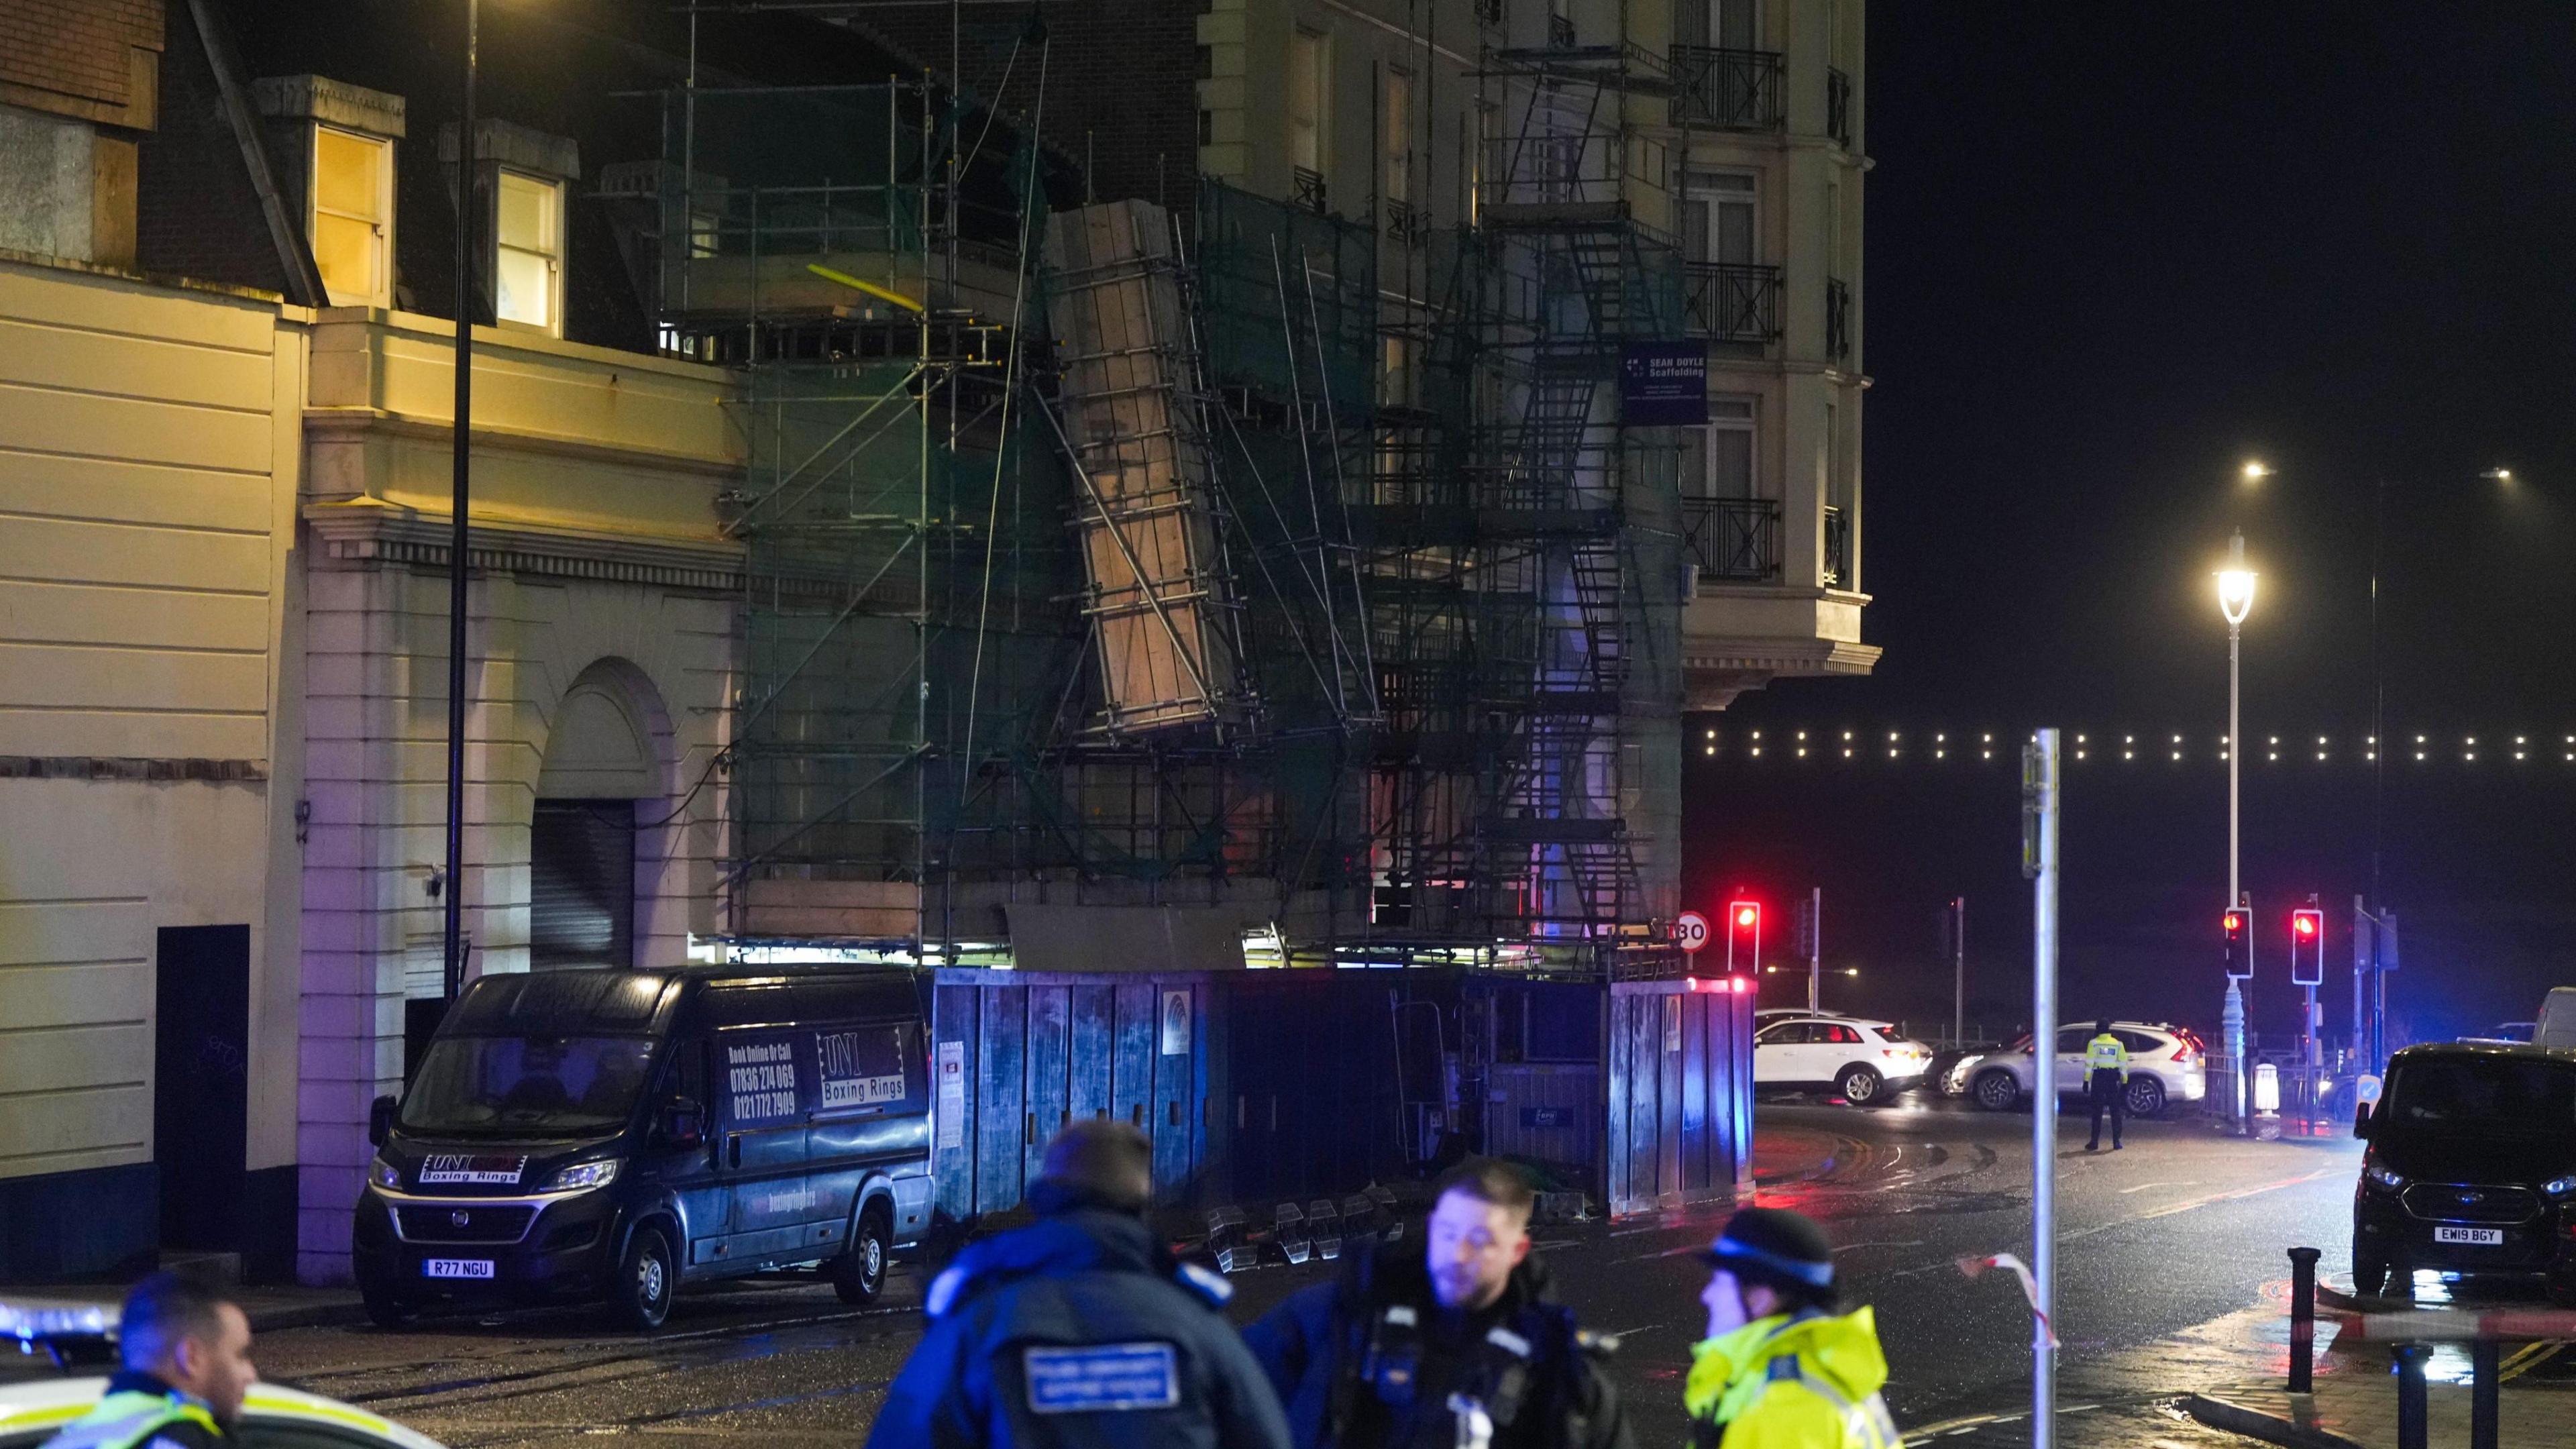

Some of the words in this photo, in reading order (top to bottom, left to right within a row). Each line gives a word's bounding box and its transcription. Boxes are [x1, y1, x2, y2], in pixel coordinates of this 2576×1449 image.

[1650, 358, 1673, 367] SEAN
[1676, 357, 1705, 367] DOYLE
[1650, 367, 1705, 378] Scaffolding
[1678, 923, 1705, 941] 30
[728, 1046, 747, 1064] Book
[746, 1044, 769, 1063] Online
[769, 1043, 777, 1061] Or
[777, 1042, 792, 1061] Call
[730, 1067, 759, 1093] 07836
[759, 1065, 775, 1090] 274
[776, 1064, 794, 1089] 069
[824, 1081, 865, 1102] Boxing
[870, 1078, 902, 1099] Rings
[771, 1091, 795, 1116] 7909
[423, 1172, 470, 1182] Boxing
[477, 1172, 517, 1182] Rings
[2442, 1228, 2469, 1240] EW19
[2472, 1230, 2496, 1242] BGY
[435, 1262, 460, 1275] R77
[463, 1262, 488, 1275] NGU
